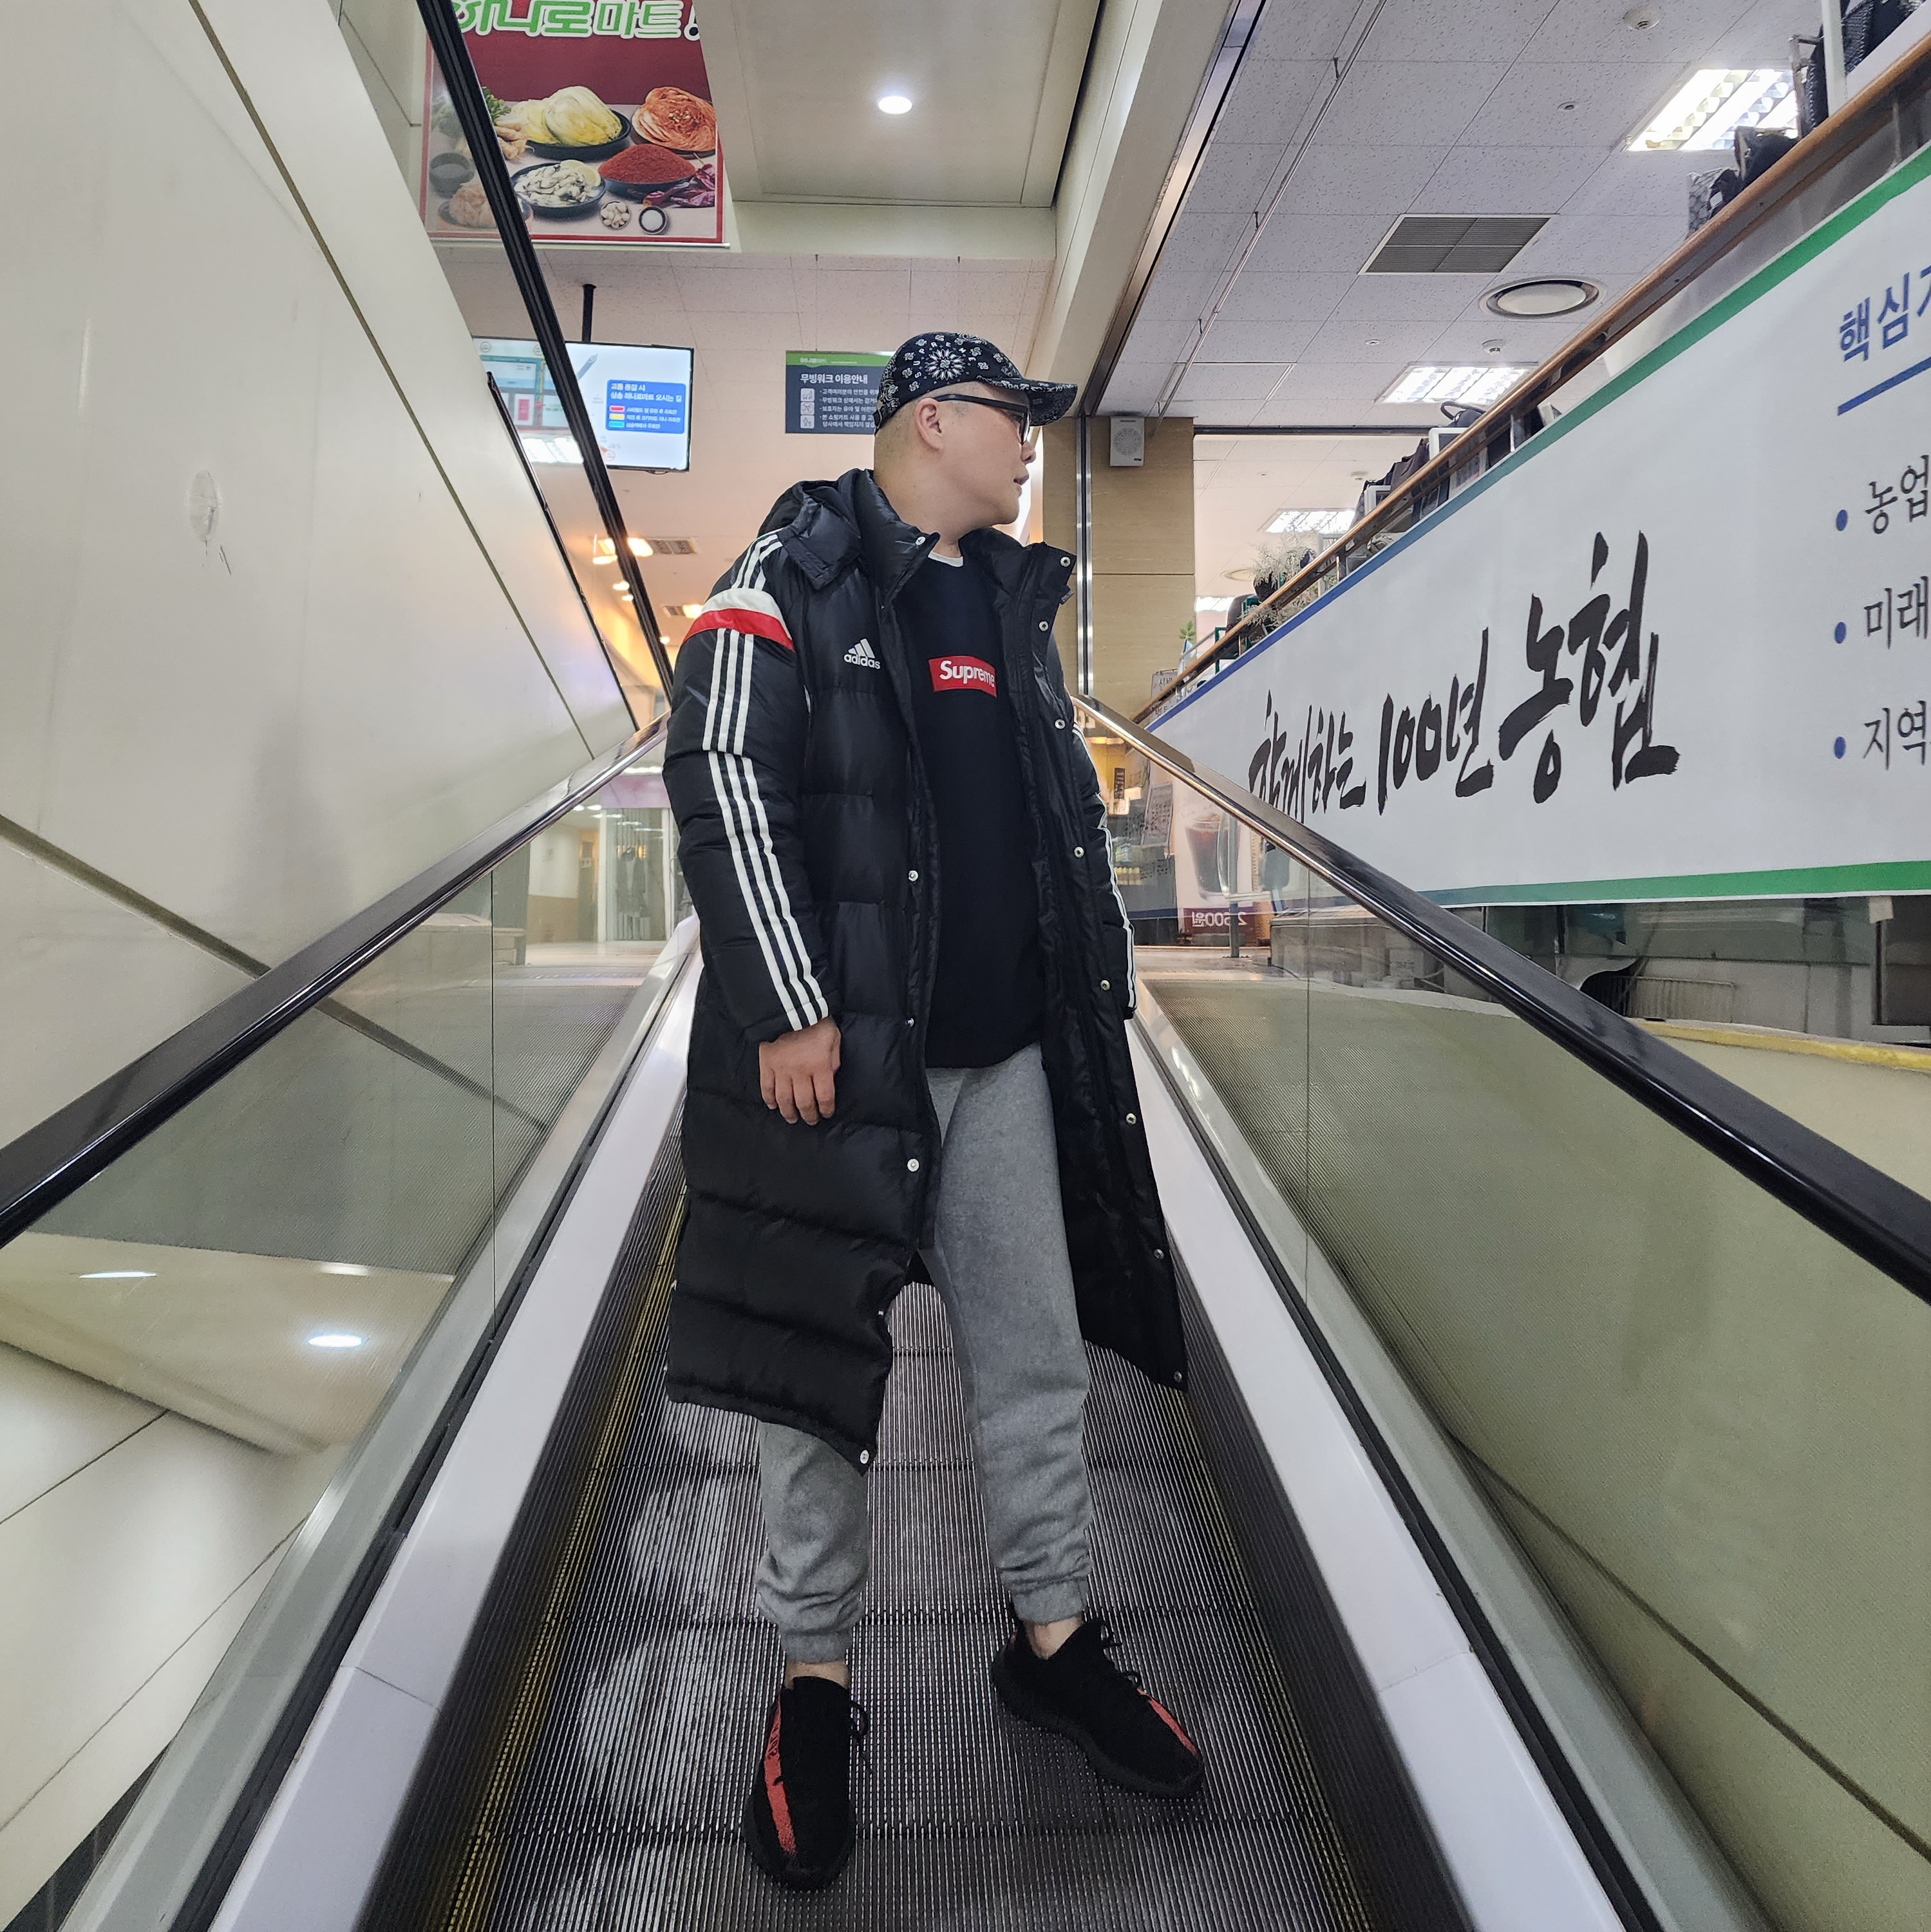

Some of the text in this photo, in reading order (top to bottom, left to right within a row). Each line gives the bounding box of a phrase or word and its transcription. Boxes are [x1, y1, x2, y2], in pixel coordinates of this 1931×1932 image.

[800, 374, 868, 384] 무빙워크 이용안내
[1865, 455, 1930, 535] 농업
[1863, 576, 1929, 649] 미래
[843, 654, 881, 670] adidas
[939, 660, 995, 688] Supreme
[1378, 627, 1494, 815] 100년
[1499, 530, 1681, 804] 농협
[1863, 701, 1926, 771] 지역
